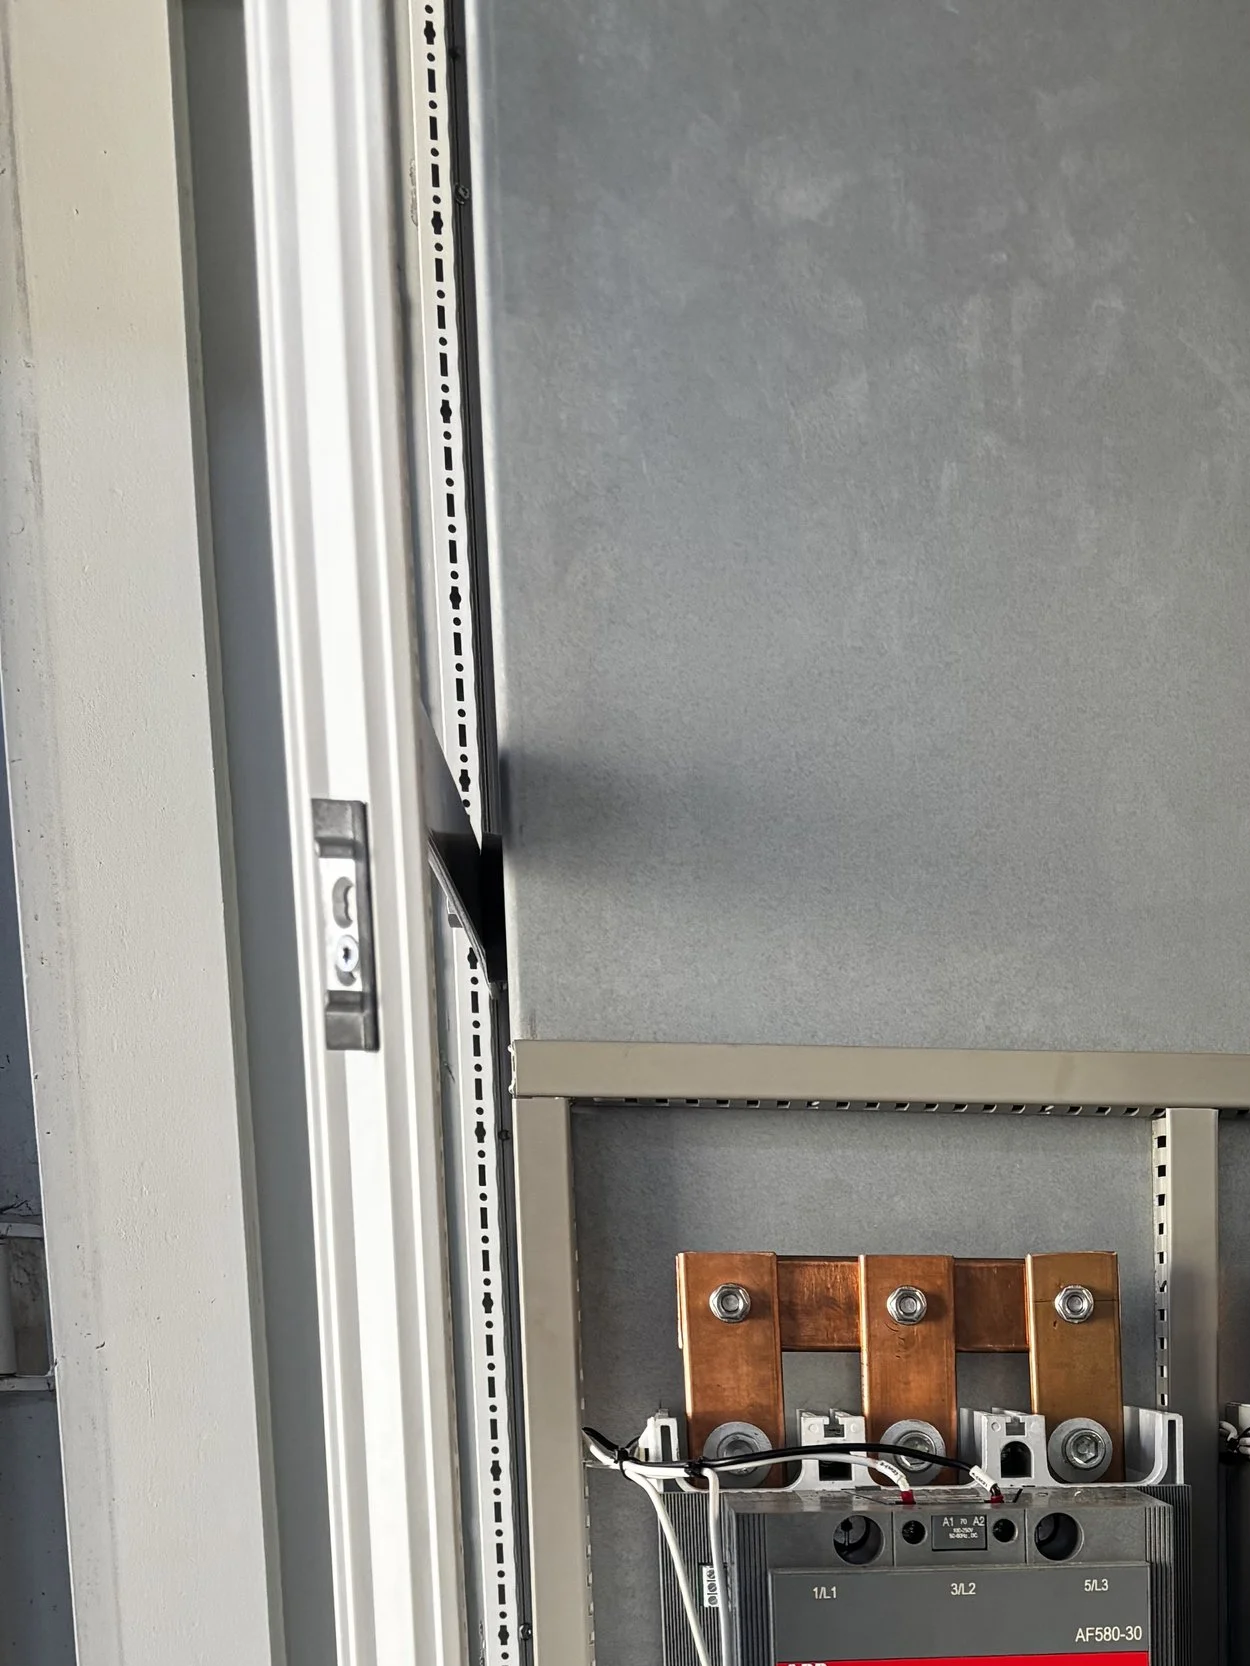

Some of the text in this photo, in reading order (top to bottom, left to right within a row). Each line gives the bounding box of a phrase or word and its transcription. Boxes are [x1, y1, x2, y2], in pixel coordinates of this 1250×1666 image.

[942, 1516, 986, 1527] A1 A2
[812, 1579, 1109, 1600] 1/L1 3/L2 5/L3
[1075, 1626, 1143, 1643] AF580-30
